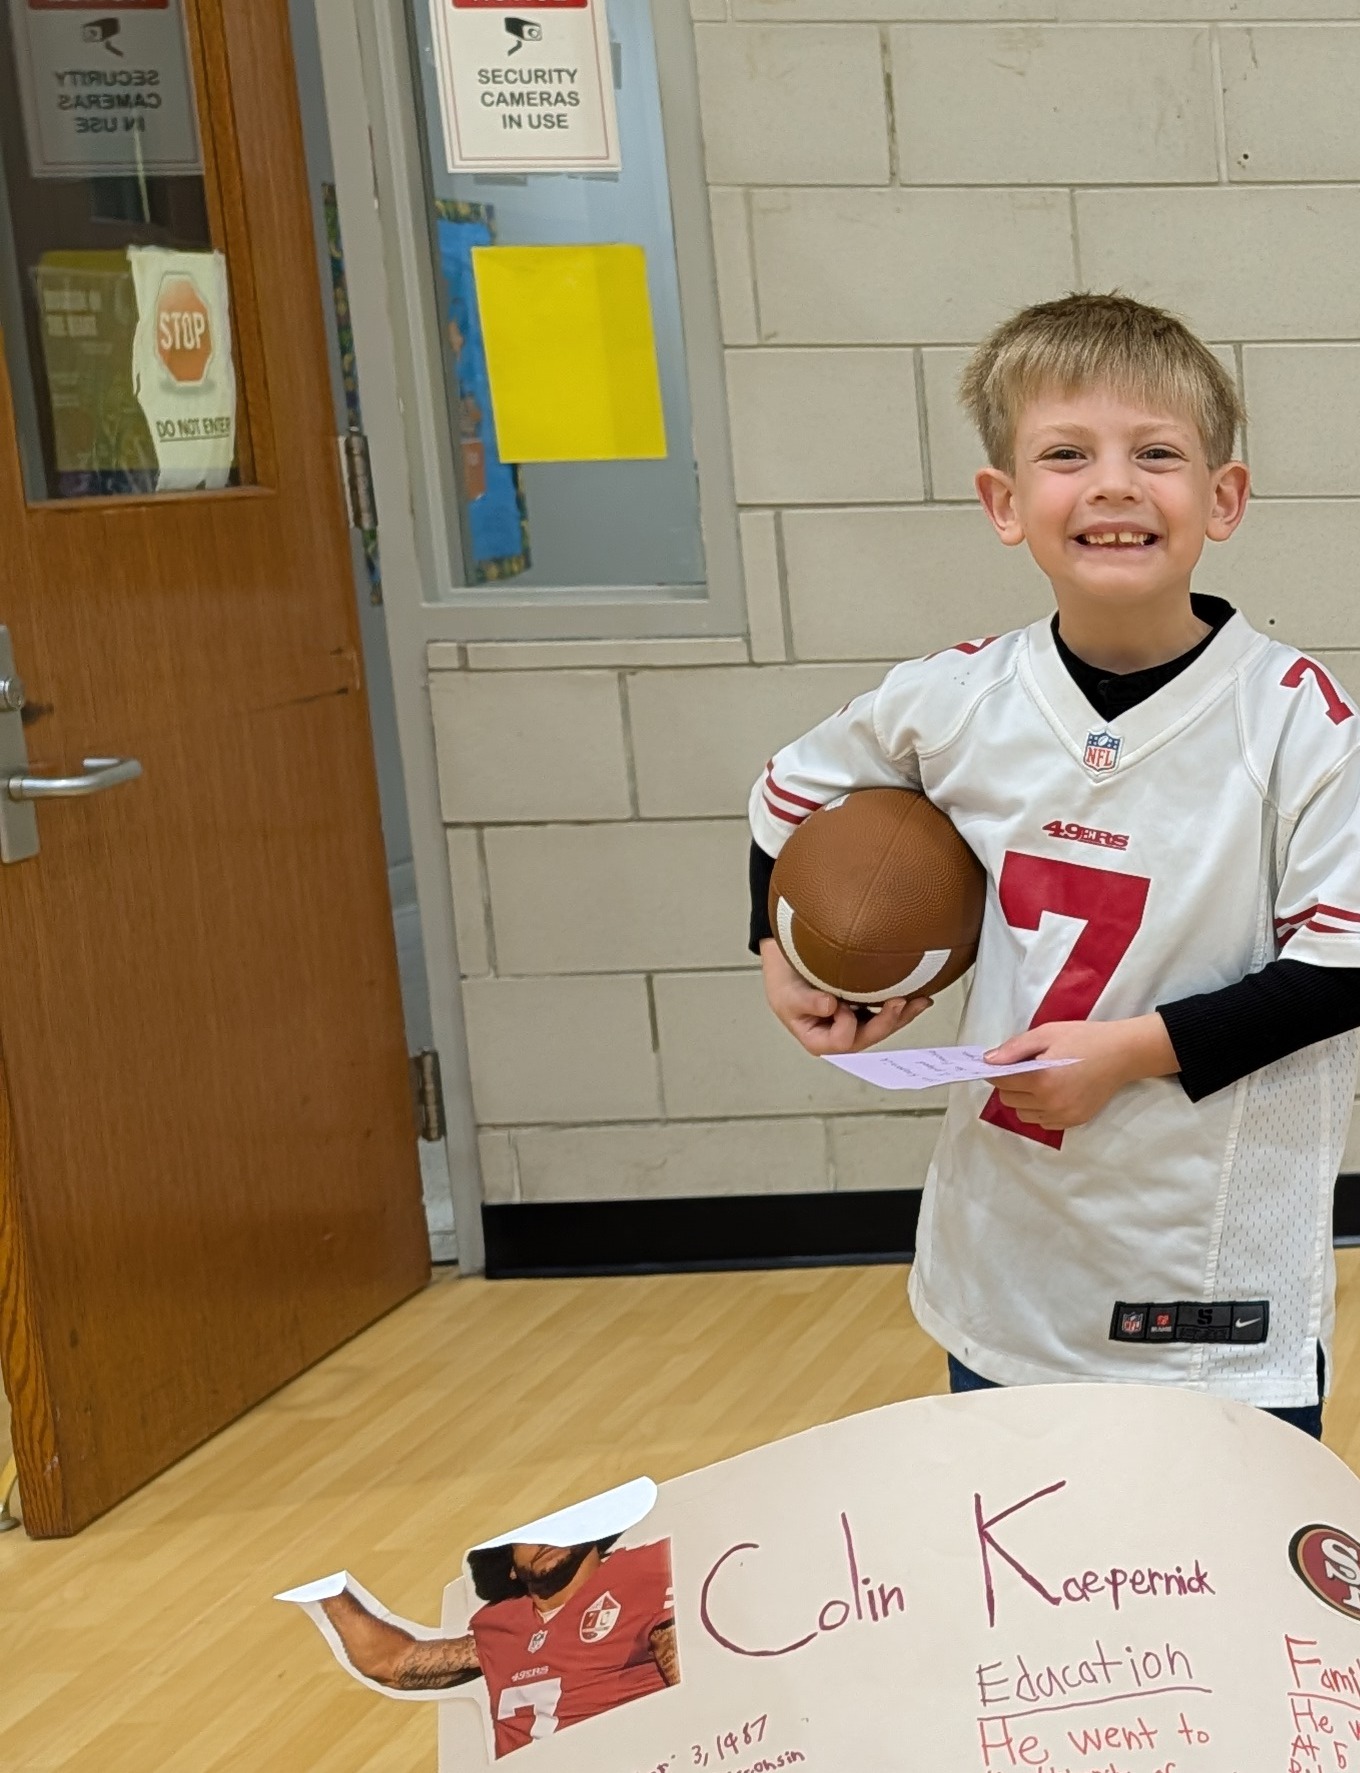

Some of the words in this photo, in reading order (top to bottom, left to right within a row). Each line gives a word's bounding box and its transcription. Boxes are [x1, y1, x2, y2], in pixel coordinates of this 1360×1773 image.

[477, 68, 578, 85] SECURITY
[480, 91, 580, 107] CAMERAS
[502, 114, 522, 129] IN
[528, 114, 569, 129] USE
[160, 311, 205, 350] STOP
[156, 419, 175, 438] DO
[177, 418, 201, 437] NOT
[1280, 657, 1353, 725] 7
[1085, 746, 1113, 767] NFL
[1042, 820, 1130, 851] 49ERS
[979, 851, 1151, 1151] 7
[974, 1480, 1216, 1627] Kaepernick
[700, 1511, 905, 1656] Colin
[1291, 1699, 1334, 1733] He
[980, 1716, 1049, 1765] He
[1067, 1717, 1158, 1755] went
[1178, 1712, 1211, 1745] to
[1291, 1734, 1320, 1762] At
